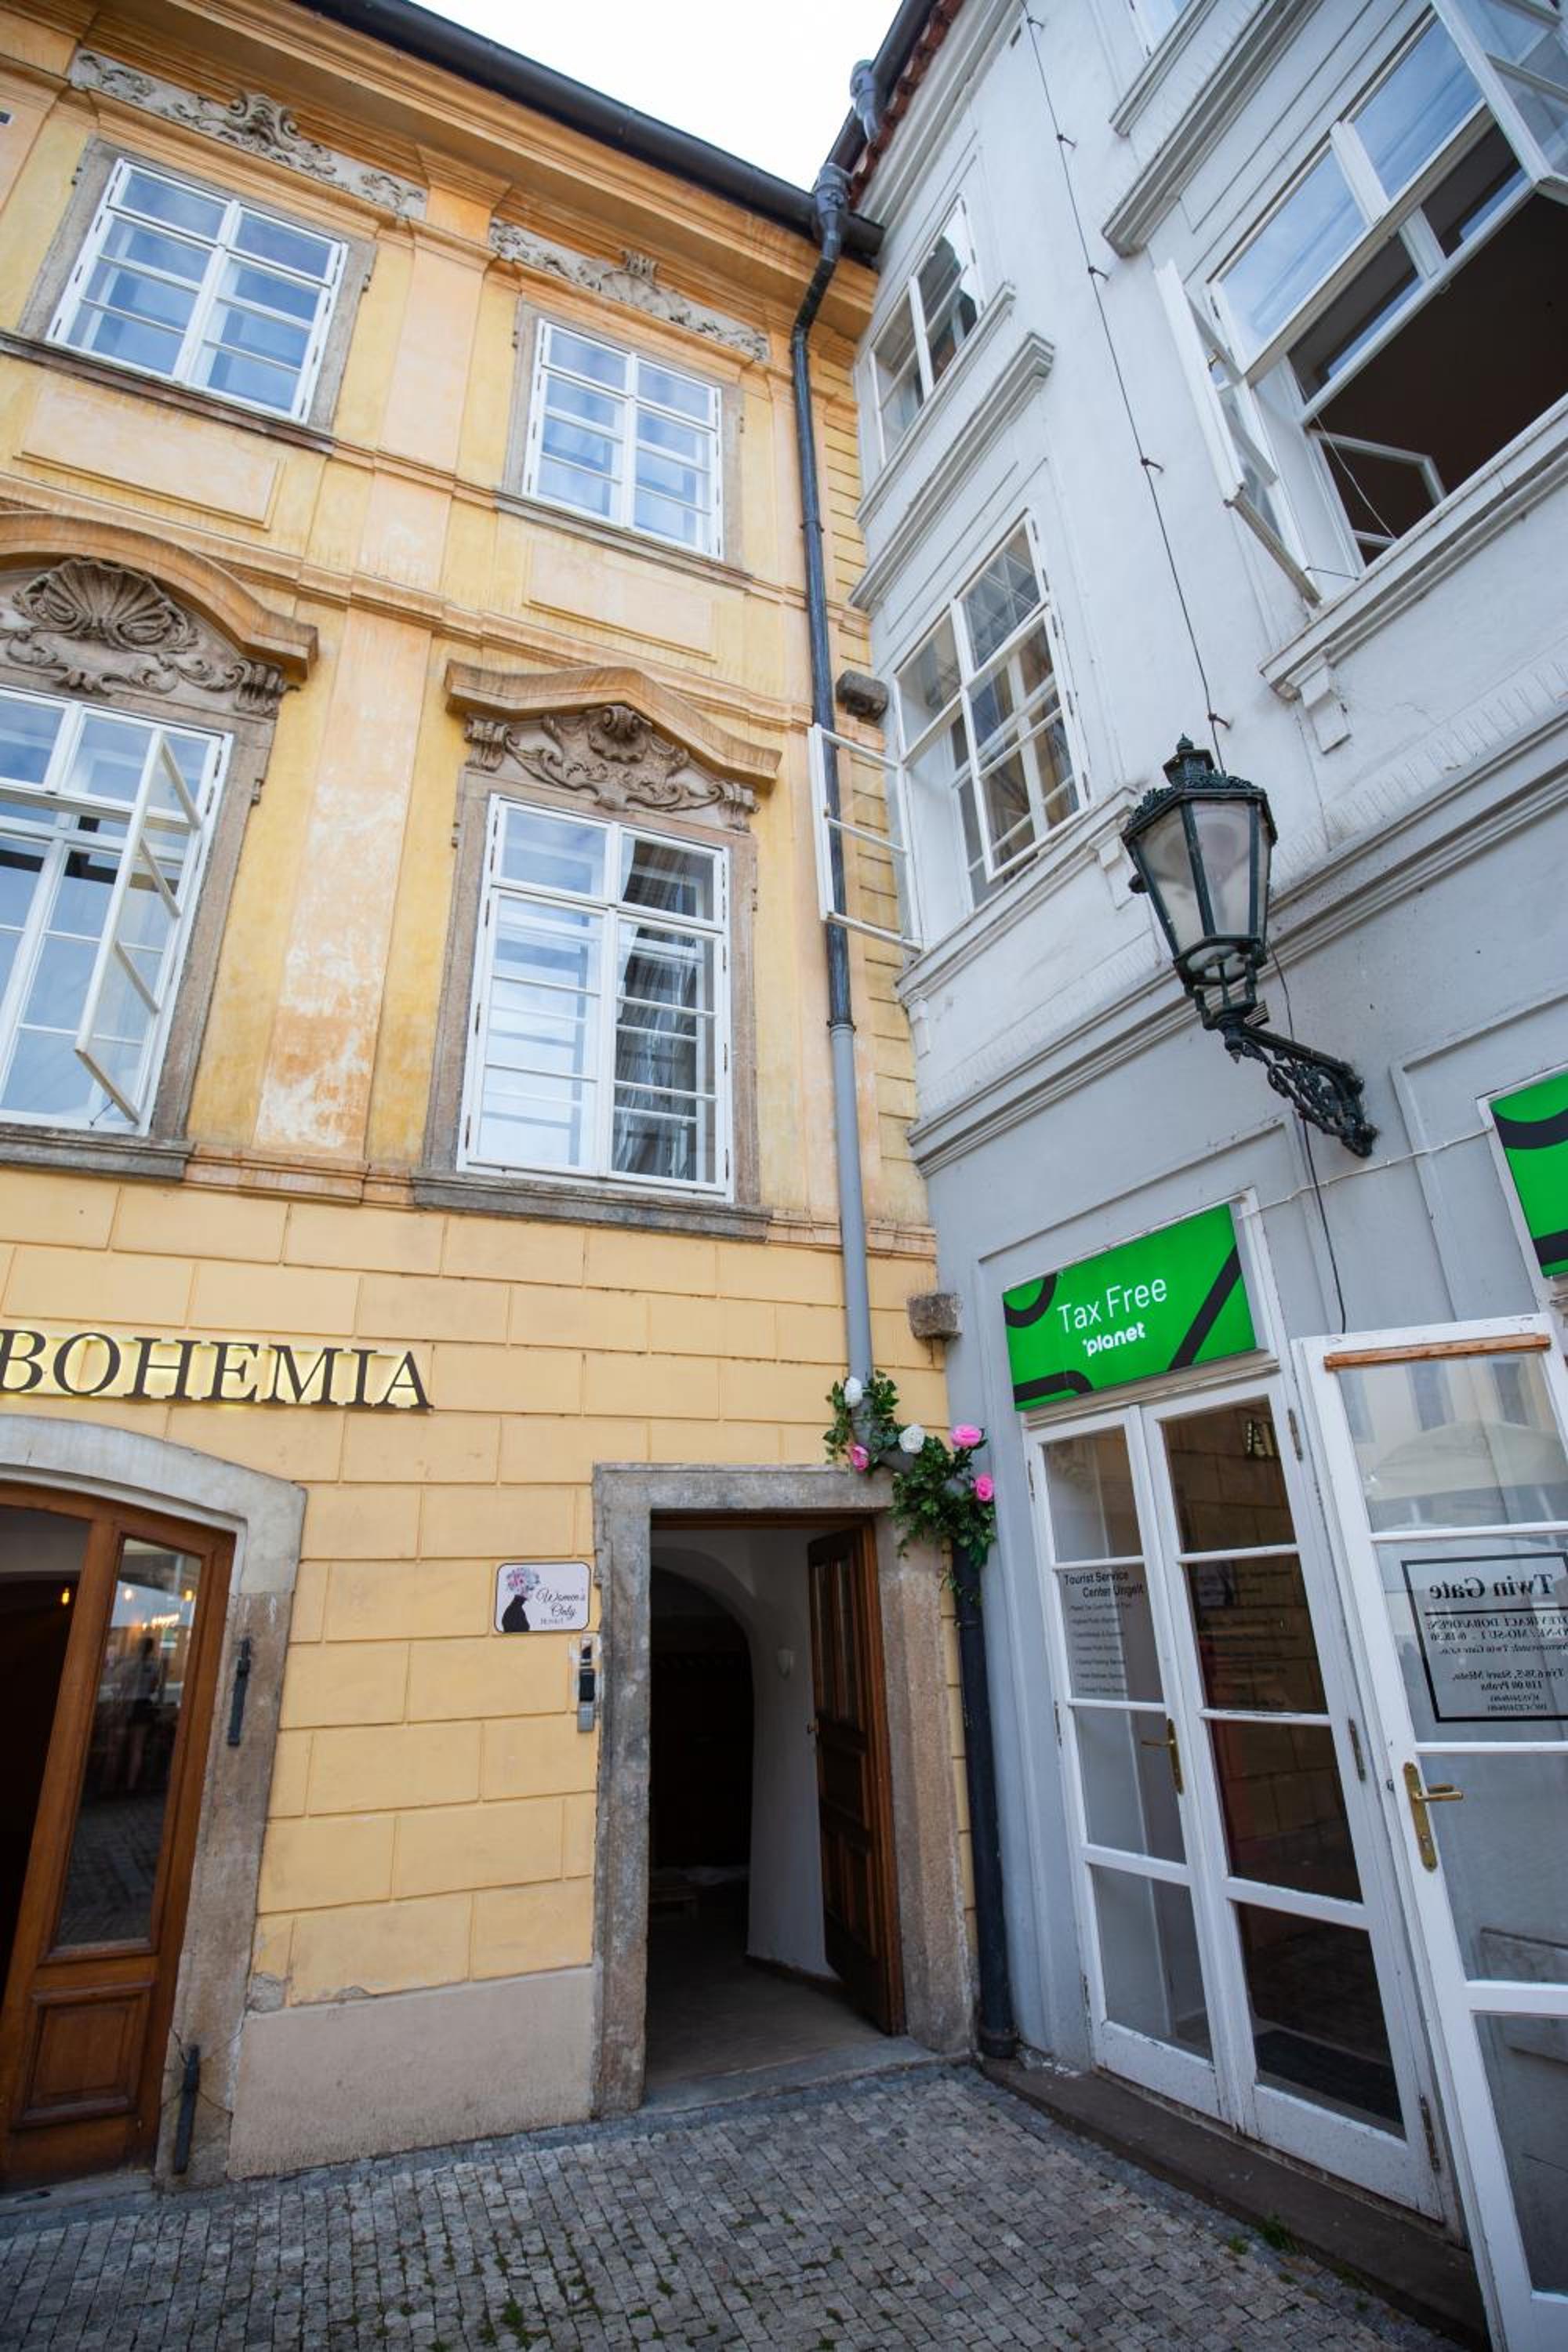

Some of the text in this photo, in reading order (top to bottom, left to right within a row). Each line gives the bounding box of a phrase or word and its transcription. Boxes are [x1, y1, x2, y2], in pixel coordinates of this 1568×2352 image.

[1057, 1278, 1167, 1334] Tax Free
[1086, 1321, 1146, 1357] planet
[0, 1328, 436, 1410] BOHEMIA
[1063, 1570, 1130, 1586] Tourist Service
[1083, 1585, 1111, 1599] Center
